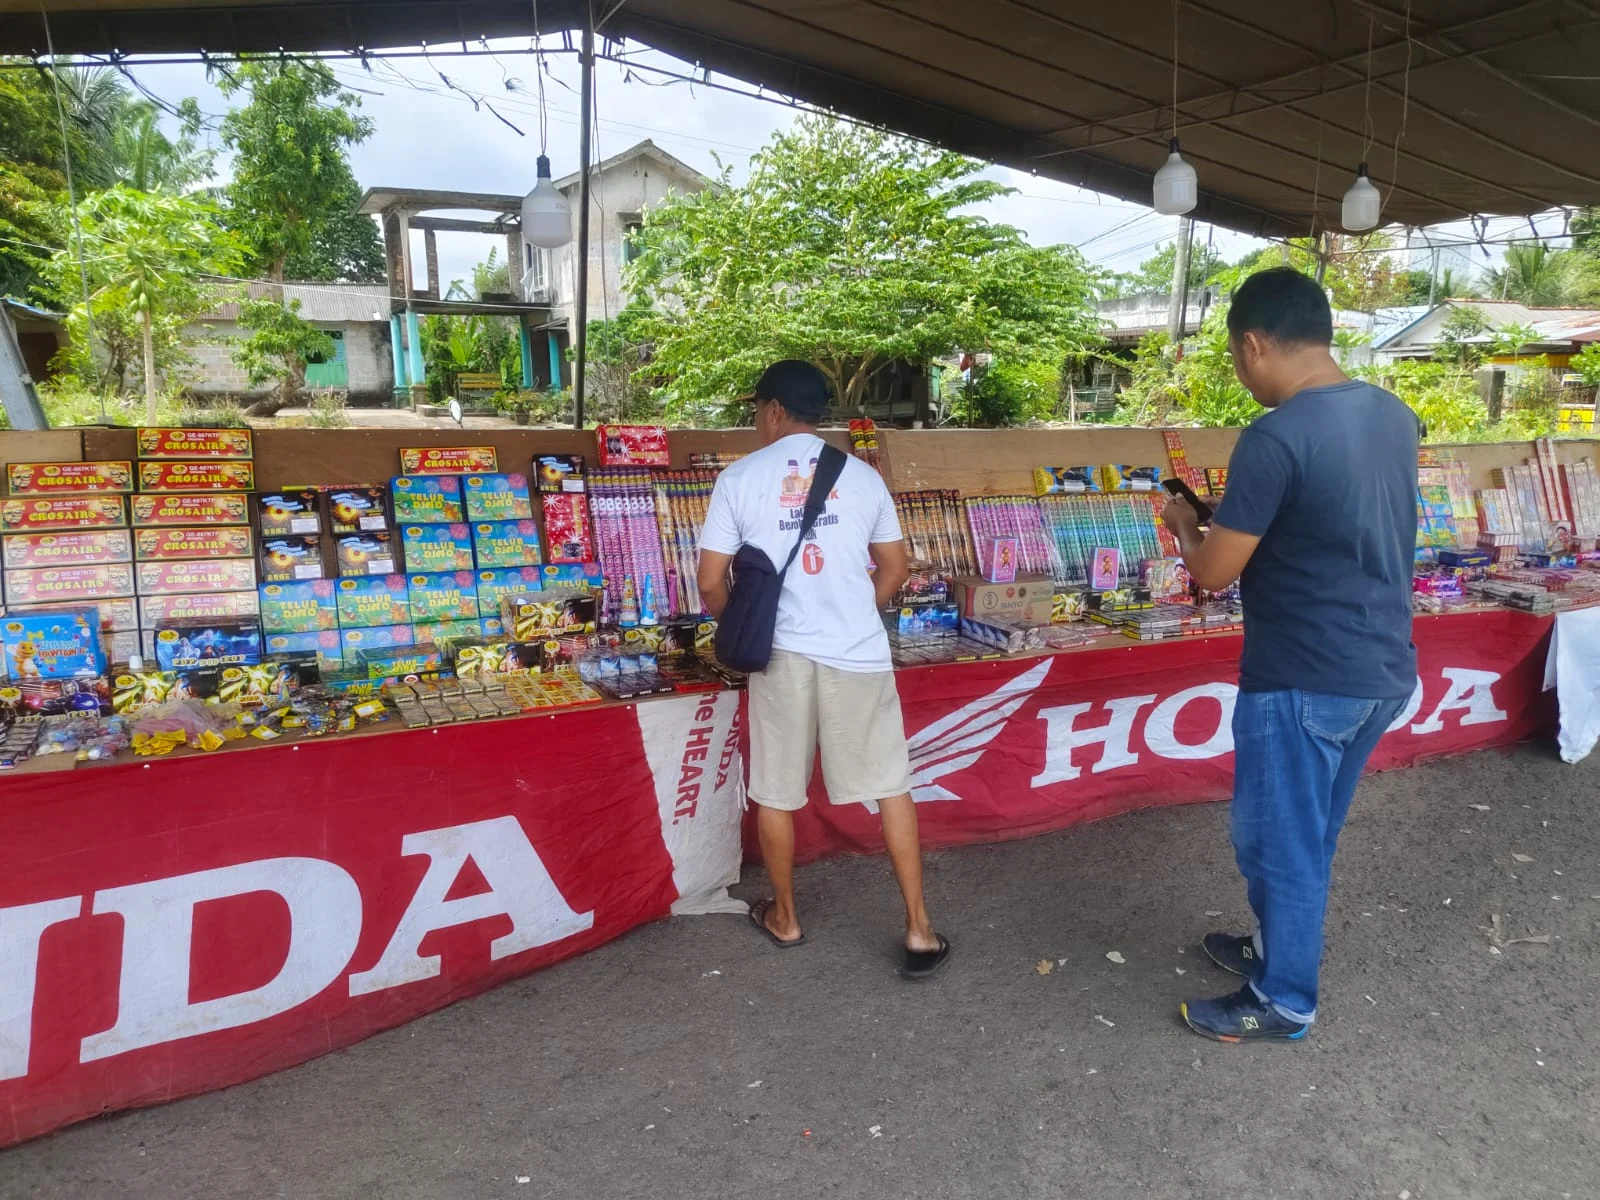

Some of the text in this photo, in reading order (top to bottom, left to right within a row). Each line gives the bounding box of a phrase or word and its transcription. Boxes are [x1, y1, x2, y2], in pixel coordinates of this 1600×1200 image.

[164, 442, 226, 450] CROSAIRS
[424, 460, 476, 468] CROSAIRS
[38, 476, 104, 485] CROSAIRS
[166, 474, 228, 483] CROSAIRS
[409, 493, 444, 502] TELUR
[481, 492, 514, 500] TELUR
[29, 511, 97, 521] CROSAIRS
[159, 508, 222, 516] CROSAIRS
[163, 542, 226, 550] CROSAIRS
[421, 541, 455, 550] TELUR
[491, 538, 523, 546] TELUR
[34, 546, 102, 556] CROSAIRS
[166, 574, 228, 583] CROSAIRS
[36, 580, 104, 591] CROSAIRS
[493, 584, 527, 593] TELUR
[425, 589, 460, 599] TELUR
[355, 594, 391, 604] TELUR
[280, 600, 318, 609] TELUR
[169, 606, 232, 617] CROSAIRS
[672, 691, 720, 825] ne HEART.
